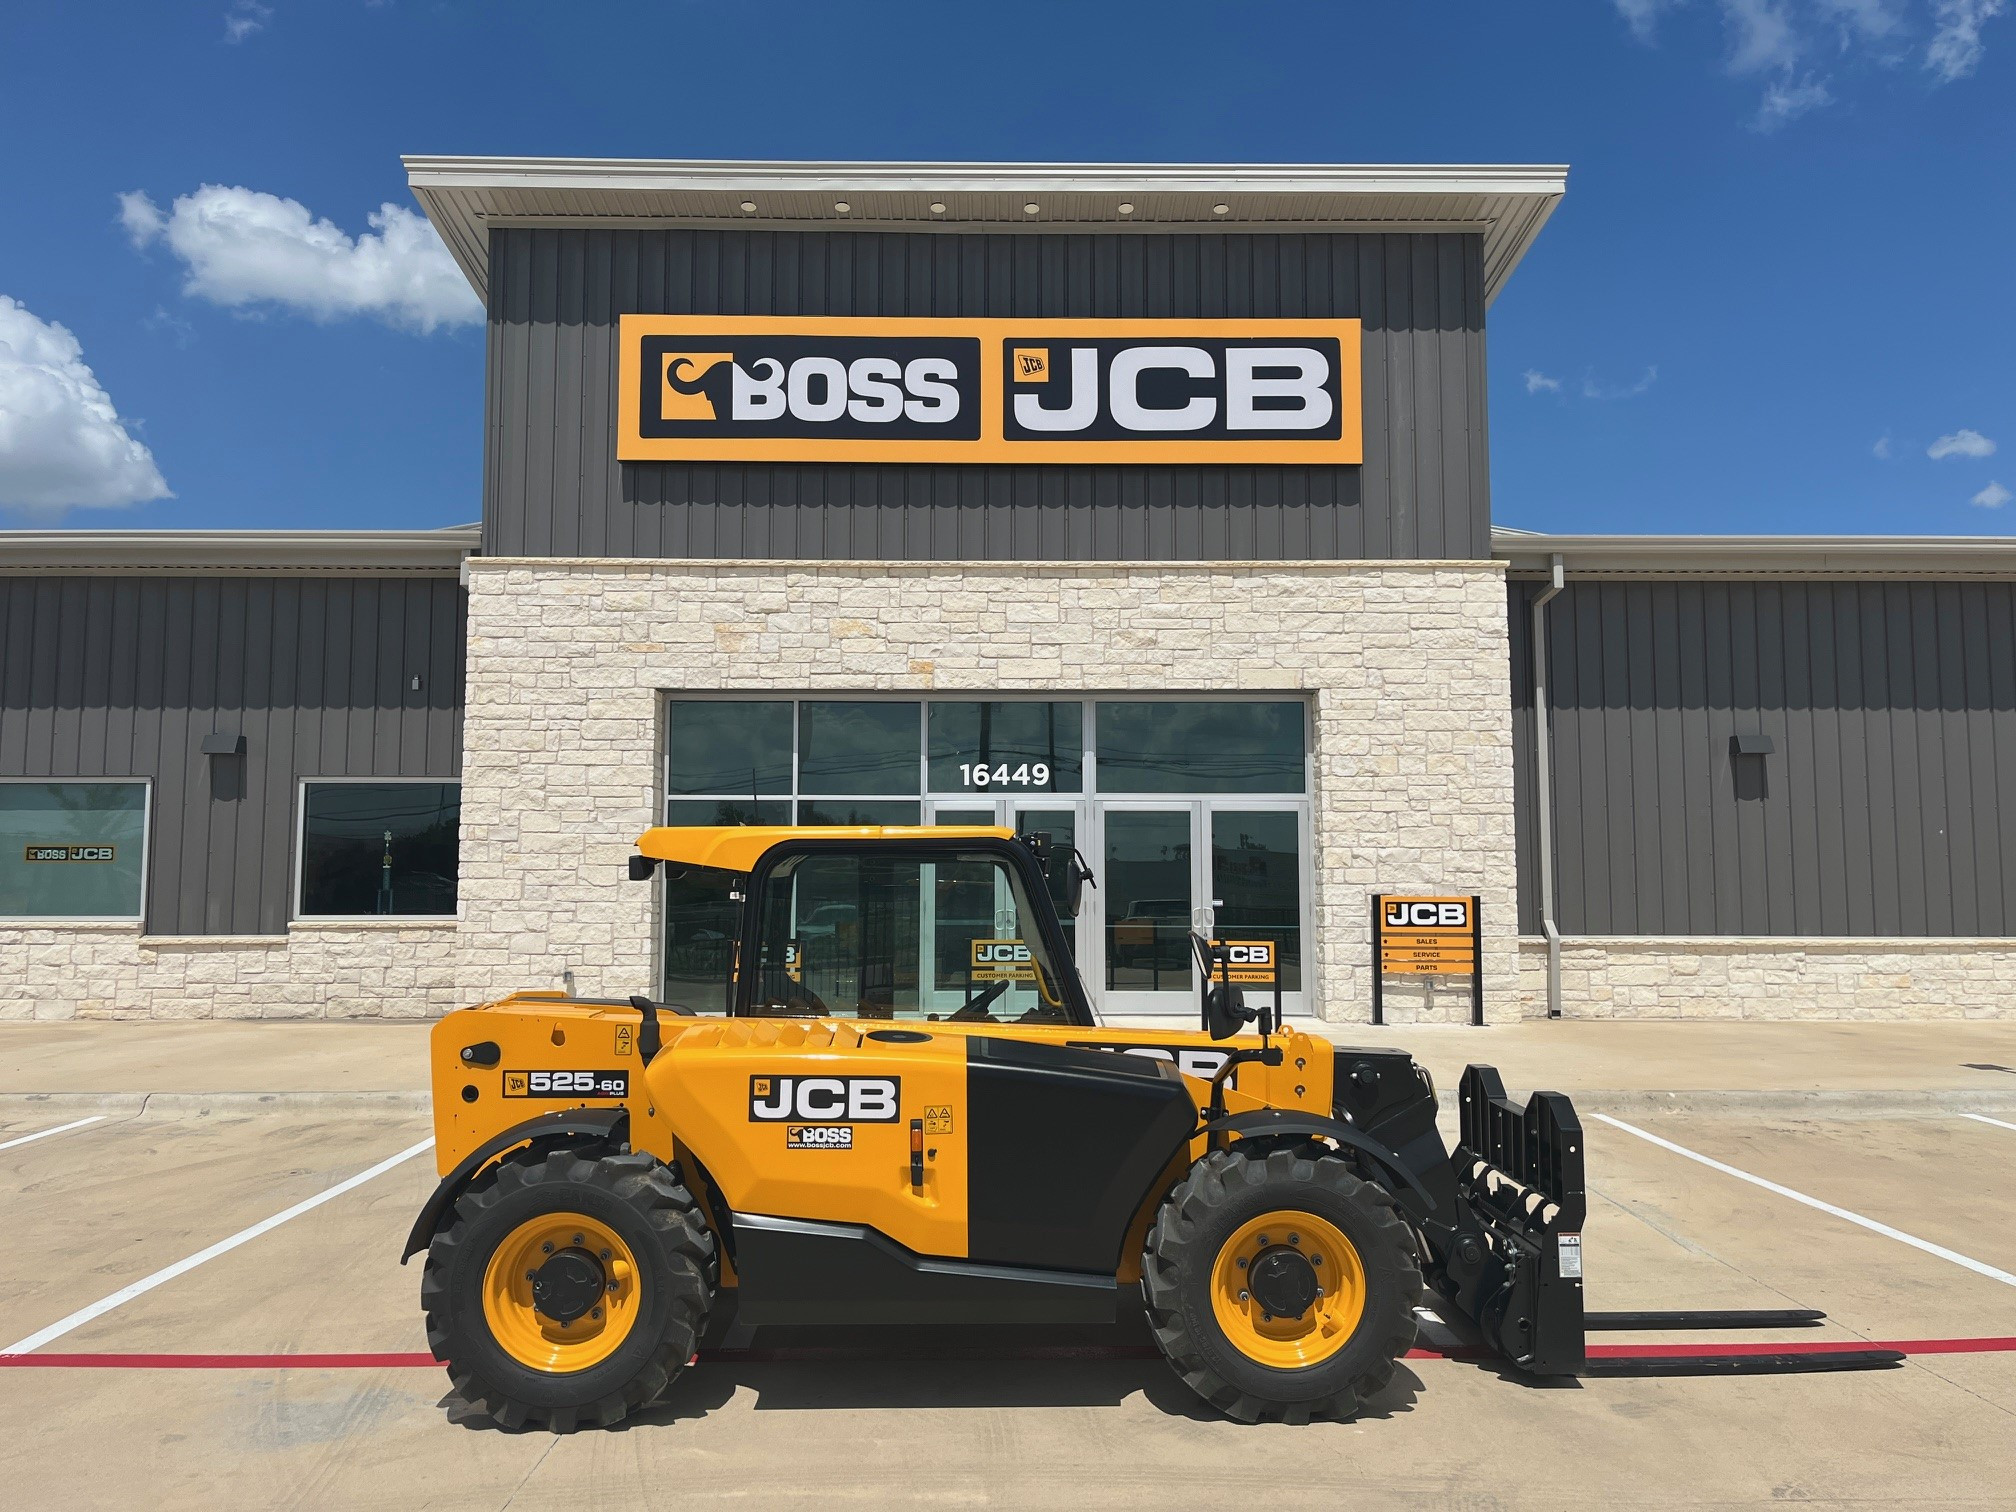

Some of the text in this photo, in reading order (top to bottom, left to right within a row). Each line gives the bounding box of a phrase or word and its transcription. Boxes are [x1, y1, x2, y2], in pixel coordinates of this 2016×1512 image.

[1023, 357, 1043, 373] JCB
[732, 346, 1333, 431] BOSS JCB
[960, 763, 1050, 786] 16449
[37, 848, 112, 860] BOSS JCB
[1387, 903, 1465, 926] JCB
[977, 945, 1031, 961] JCB
[530, 1072, 625, 1091] 525-60
[754, 1079, 896, 1119] JCB
[803, 1128, 851, 1143] BOSS
